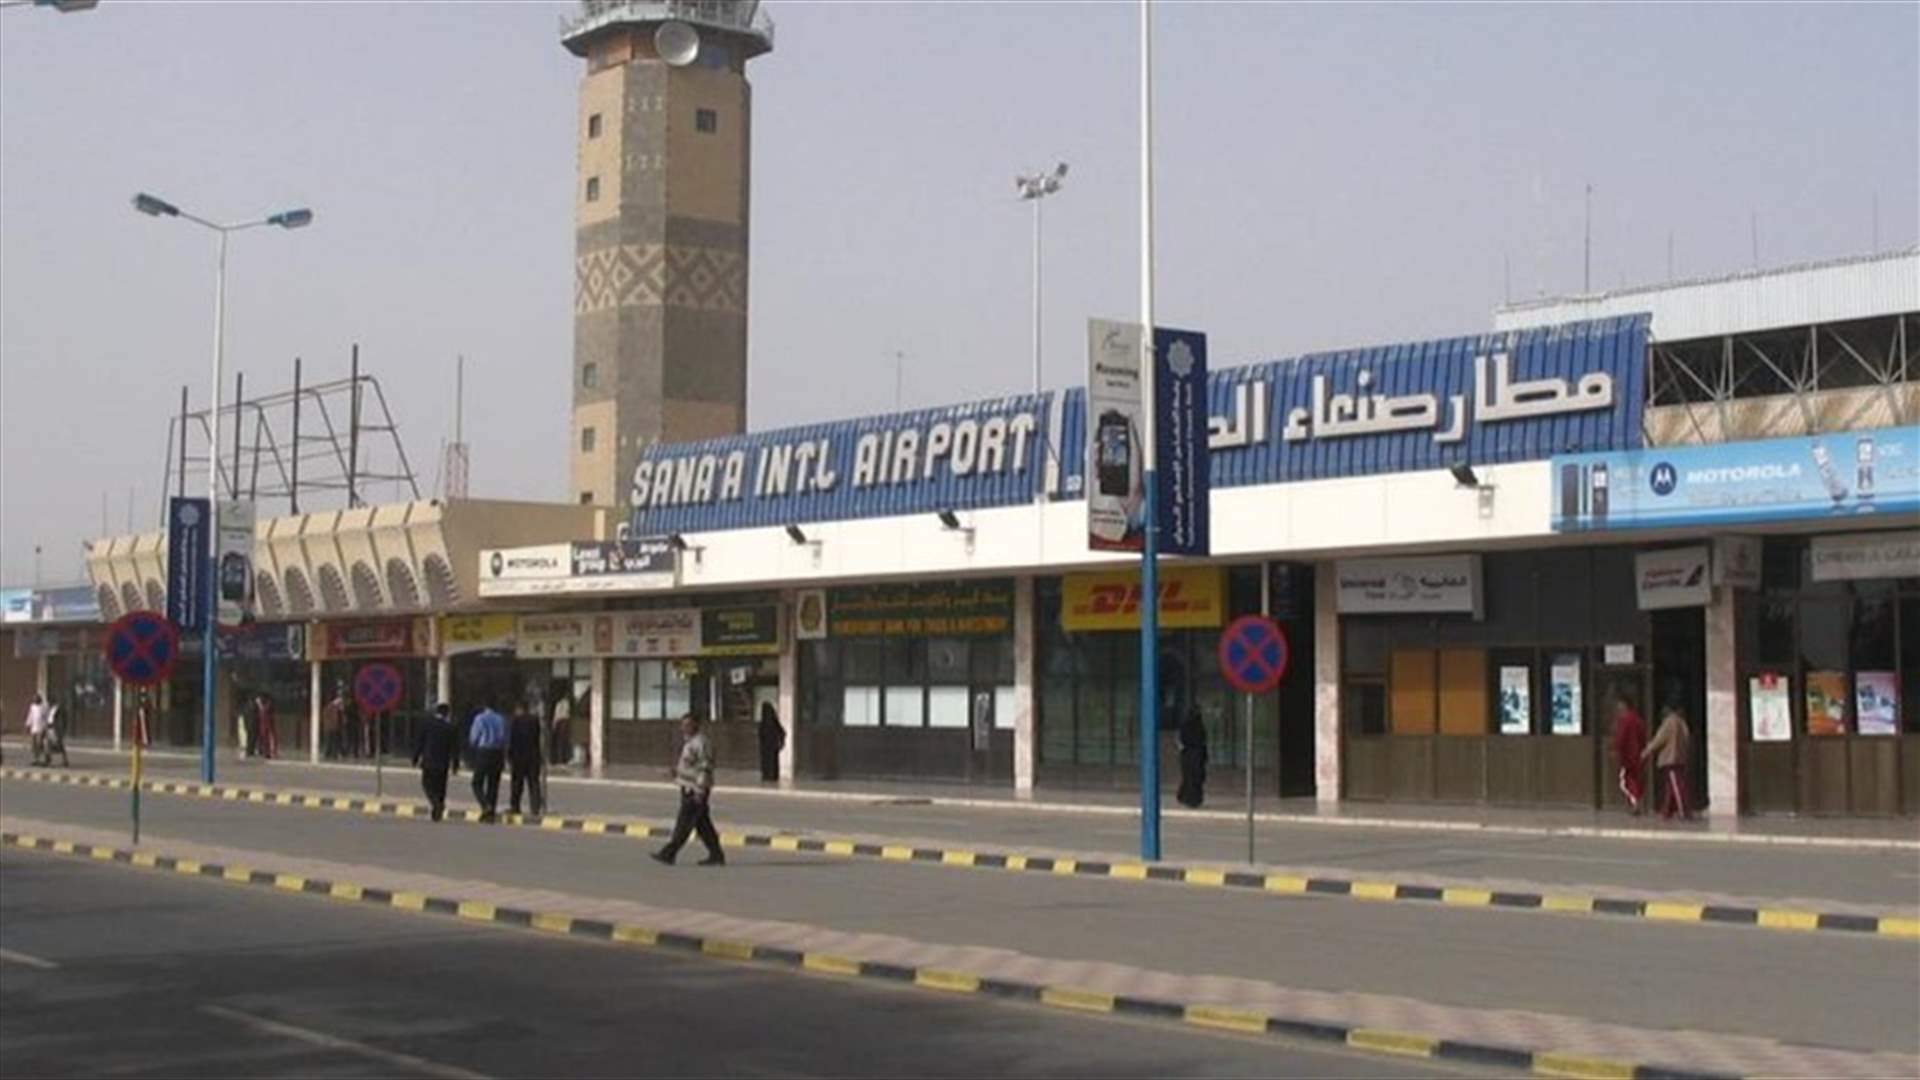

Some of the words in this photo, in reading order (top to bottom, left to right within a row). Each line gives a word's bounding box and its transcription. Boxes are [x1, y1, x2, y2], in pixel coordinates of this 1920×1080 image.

[1283, 369, 1438, 441] صنعاء
[1434, 353, 1614, 442] مطار
[631, 451, 744, 507] SANA'A
[853, 413, 1034, 487] AIRPORT
[1687, 463, 1800, 484] MOTOROLA
[1091, 581, 1190, 615] DHL
